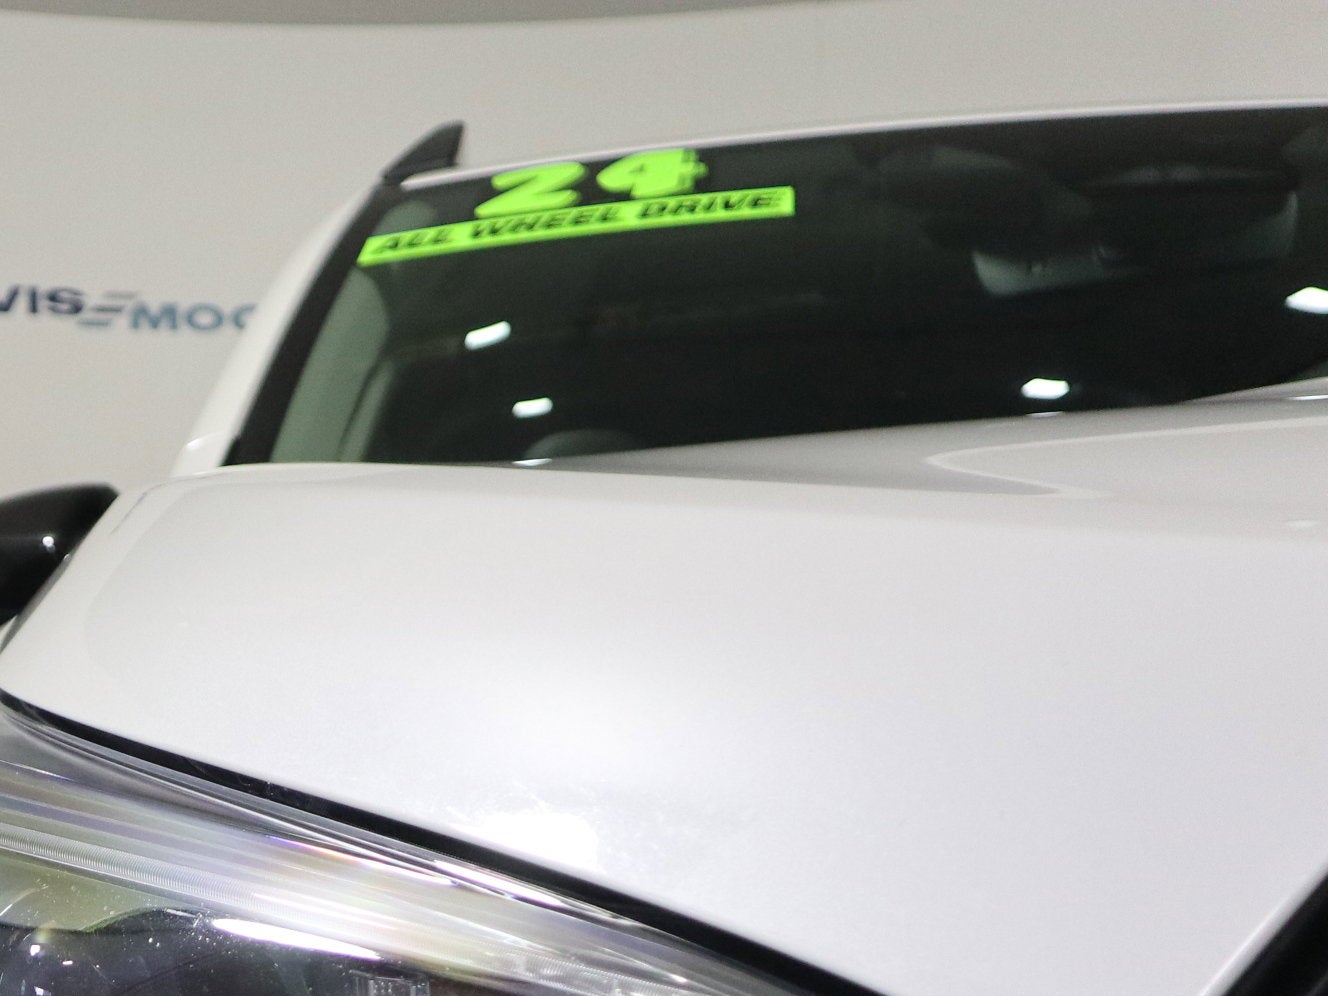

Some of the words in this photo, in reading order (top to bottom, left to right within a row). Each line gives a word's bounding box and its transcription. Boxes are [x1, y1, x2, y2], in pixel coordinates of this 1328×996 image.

[474, 148, 709, 218] 24
[374, 227, 455, 254] ALL
[469, 205, 621, 239] WHEEL
[637, 190, 784, 219] DRIVE
